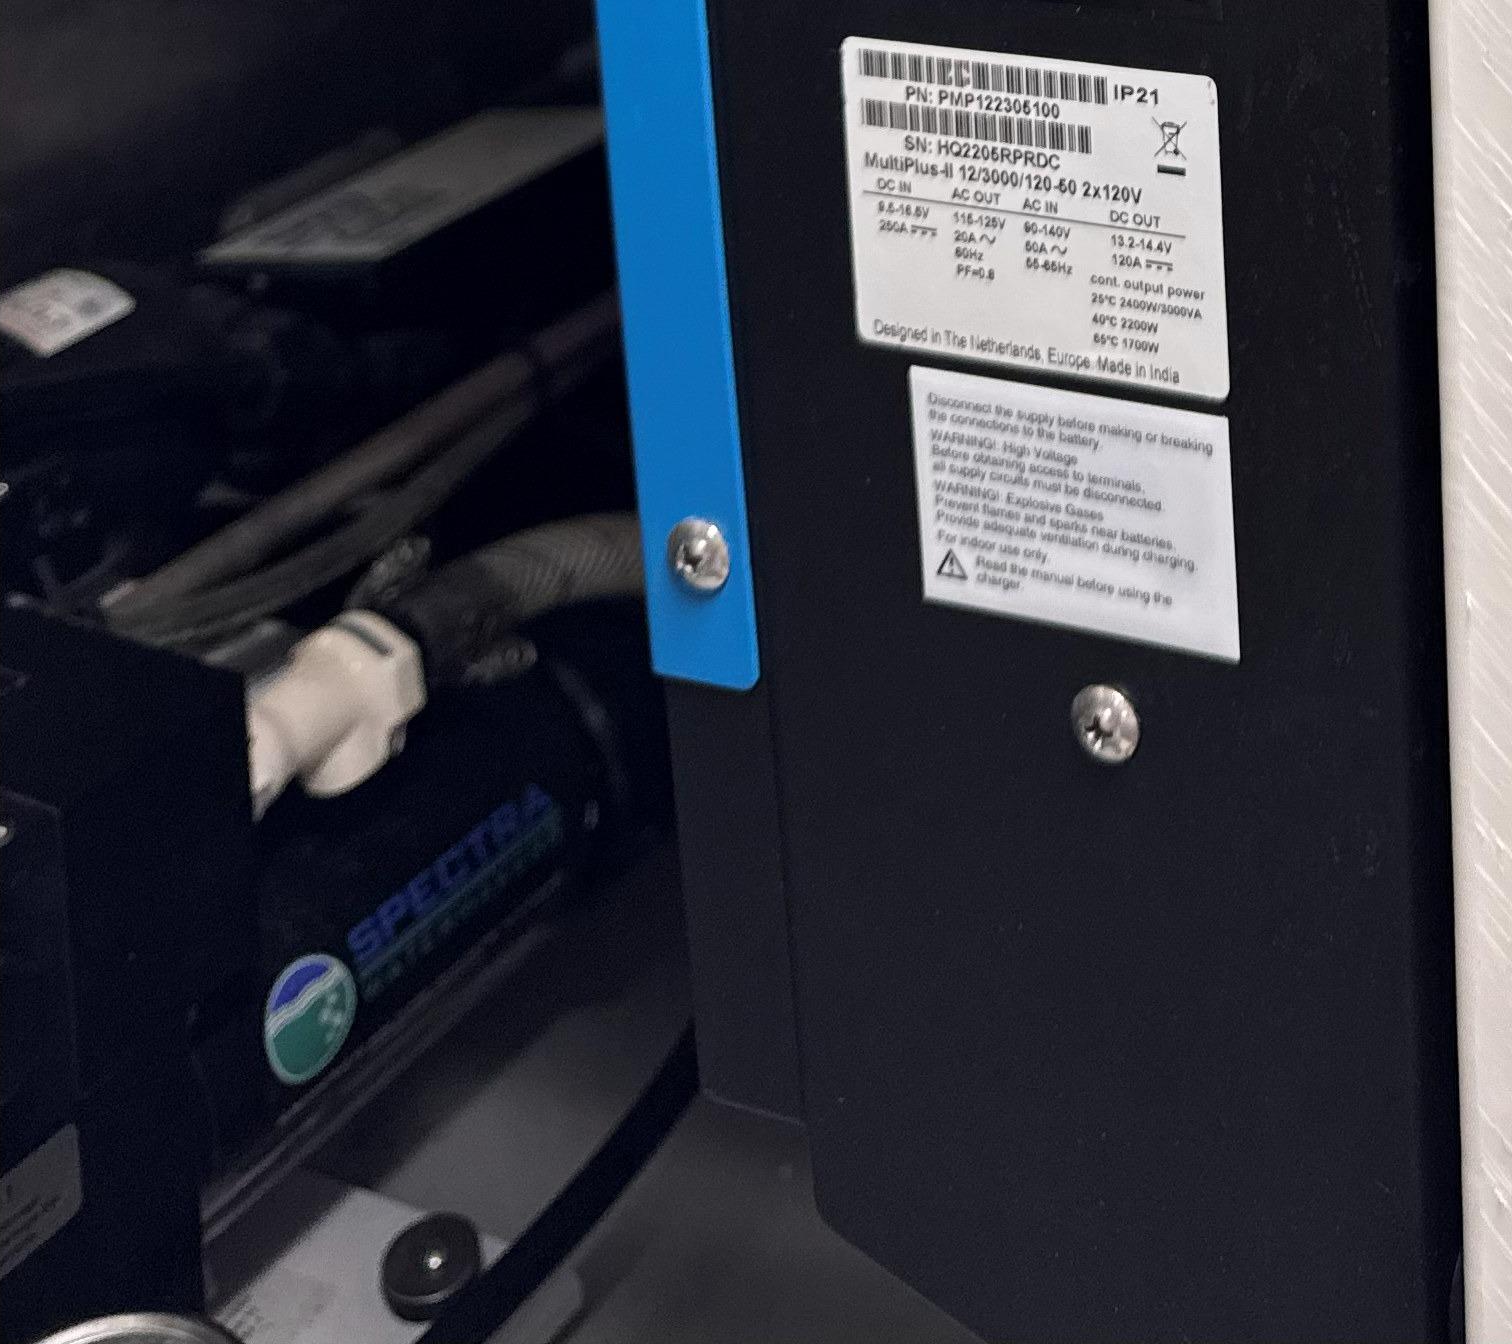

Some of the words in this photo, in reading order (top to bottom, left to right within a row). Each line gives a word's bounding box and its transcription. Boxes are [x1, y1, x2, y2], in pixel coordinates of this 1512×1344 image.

[905, 85, 933, 104] PN:
[938, 89, 1060, 118] PMP122305100
[1114, 84, 1159, 105] IP21
[904, 135, 933, 153] SN:
[877, 178, 895, 191] DC
[899, 180, 912, 193] IN
[952, 187, 970, 200] AC
[974, 190, 1001, 205] OUT
[1082, 181, 1142, 204] 2x120V
[1023, 198, 1041, 211] AC
[1046, 200, 1058, 213] IN
[1110, 211, 1128, 224] DC
[1133, 213, 1161, 228] OUT
[1110, 234, 1172, 254] 13.2-14.4V
[1112, 254, 1142, 269] 120A
[1090, 274, 1120, 287] cont.
[1124, 278, 1164, 295] output
[1167, 286, 1205, 300] power
[873, 318, 928, 342] Designed
[931, 328, 941, 344] in
[945, 330, 967, 349] The
[1097, 355, 1131, 376] Made
[1135, 361, 1146, 377] in
[1151, 362, 1180, 384] India
[928, 392, 991, 414] Disconnect
[995, 405, 1013, 418] the
[1017, 410, 1055, 427] supply
[1057, 414, 1095, 432] before
[1099, 423, 1142, 443] making
[1145, 431, 1158, 443] or
[1160, 433, 1213, 457] breaking
[928, 408, 947, 422] the
[950, 413, 1020, 435] connections
[1023, 425, 1034, 437] to
[1037, 427, 1055, 441] the
[932, 444, 970, 461] Before
[1029, 463, 1069, 479] access
[1072, 470, 1084, 481] to
[1003, 440, 1031, 459] High
[1034, 446, 1078, 467] Voltage
[949, 463, 986, 481] supply
[1032, 480, 1061, 494] must
[1064, 484, 1079, 497] be
[935, 494, 979, 512] Prevent
[1024, 513, 1046, 526] and
[1049, 517, 1087, 534] sparks
[1091, 526, 1118, 539] near
[1006, 492, 1061, 513] Explosive
[1065, 503, 1104, 521] Gases
[936, 509, 980, 529] Provide
[1102, 542, 1140, 562] during
[938, 529, 957, 543] For
[999, 543, 1020, 556] use
[976, 555, 1007, 573] Read
[1010, 563, 1028, 577] the
[1031, 566, 1073, 586] manual
[1077, 577, 1114, 595] before
[1118, 586, 1151, 604] using
[347, 783, 553, 962] SPECTRA
